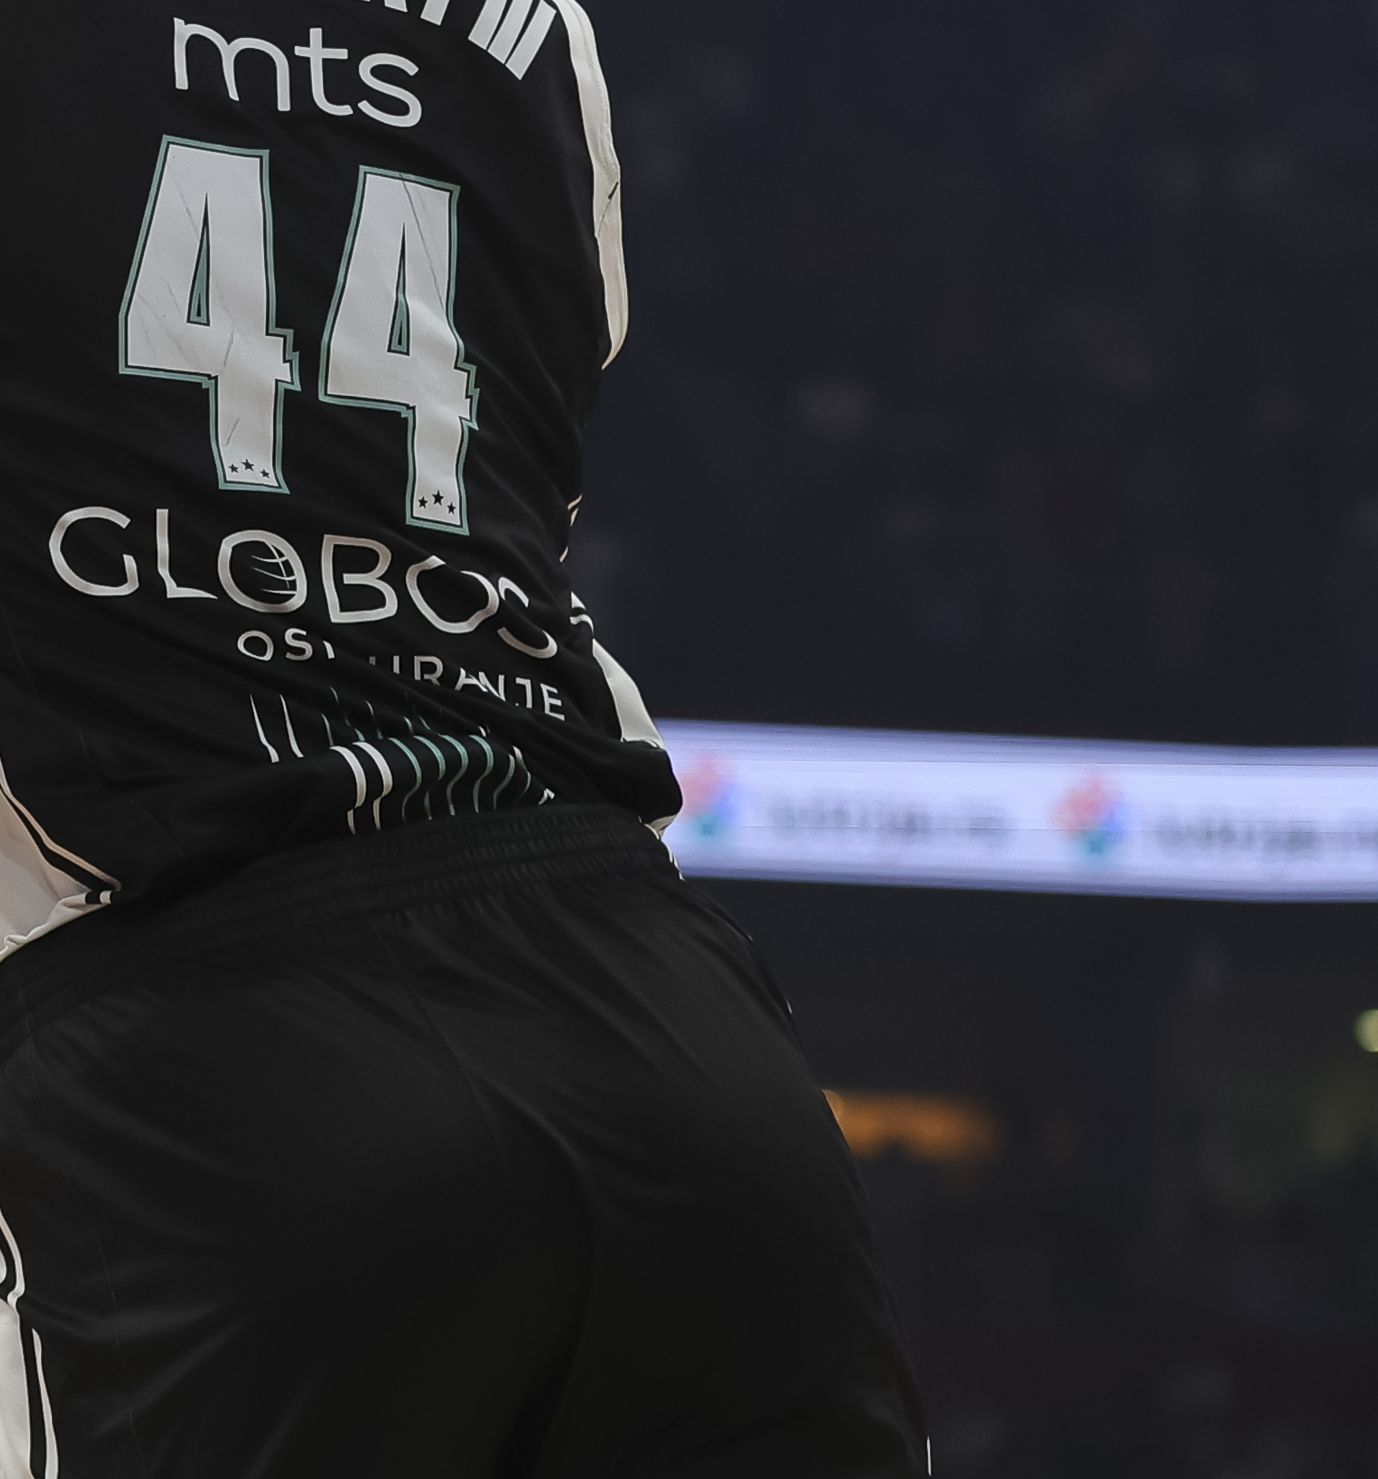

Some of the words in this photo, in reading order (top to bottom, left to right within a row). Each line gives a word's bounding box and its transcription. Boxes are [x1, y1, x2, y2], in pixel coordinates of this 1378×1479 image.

[173, 17, 422, 127] mts
[118, 134, 479, 535] 44
[48, 506, 558, 659] GLOBOS
